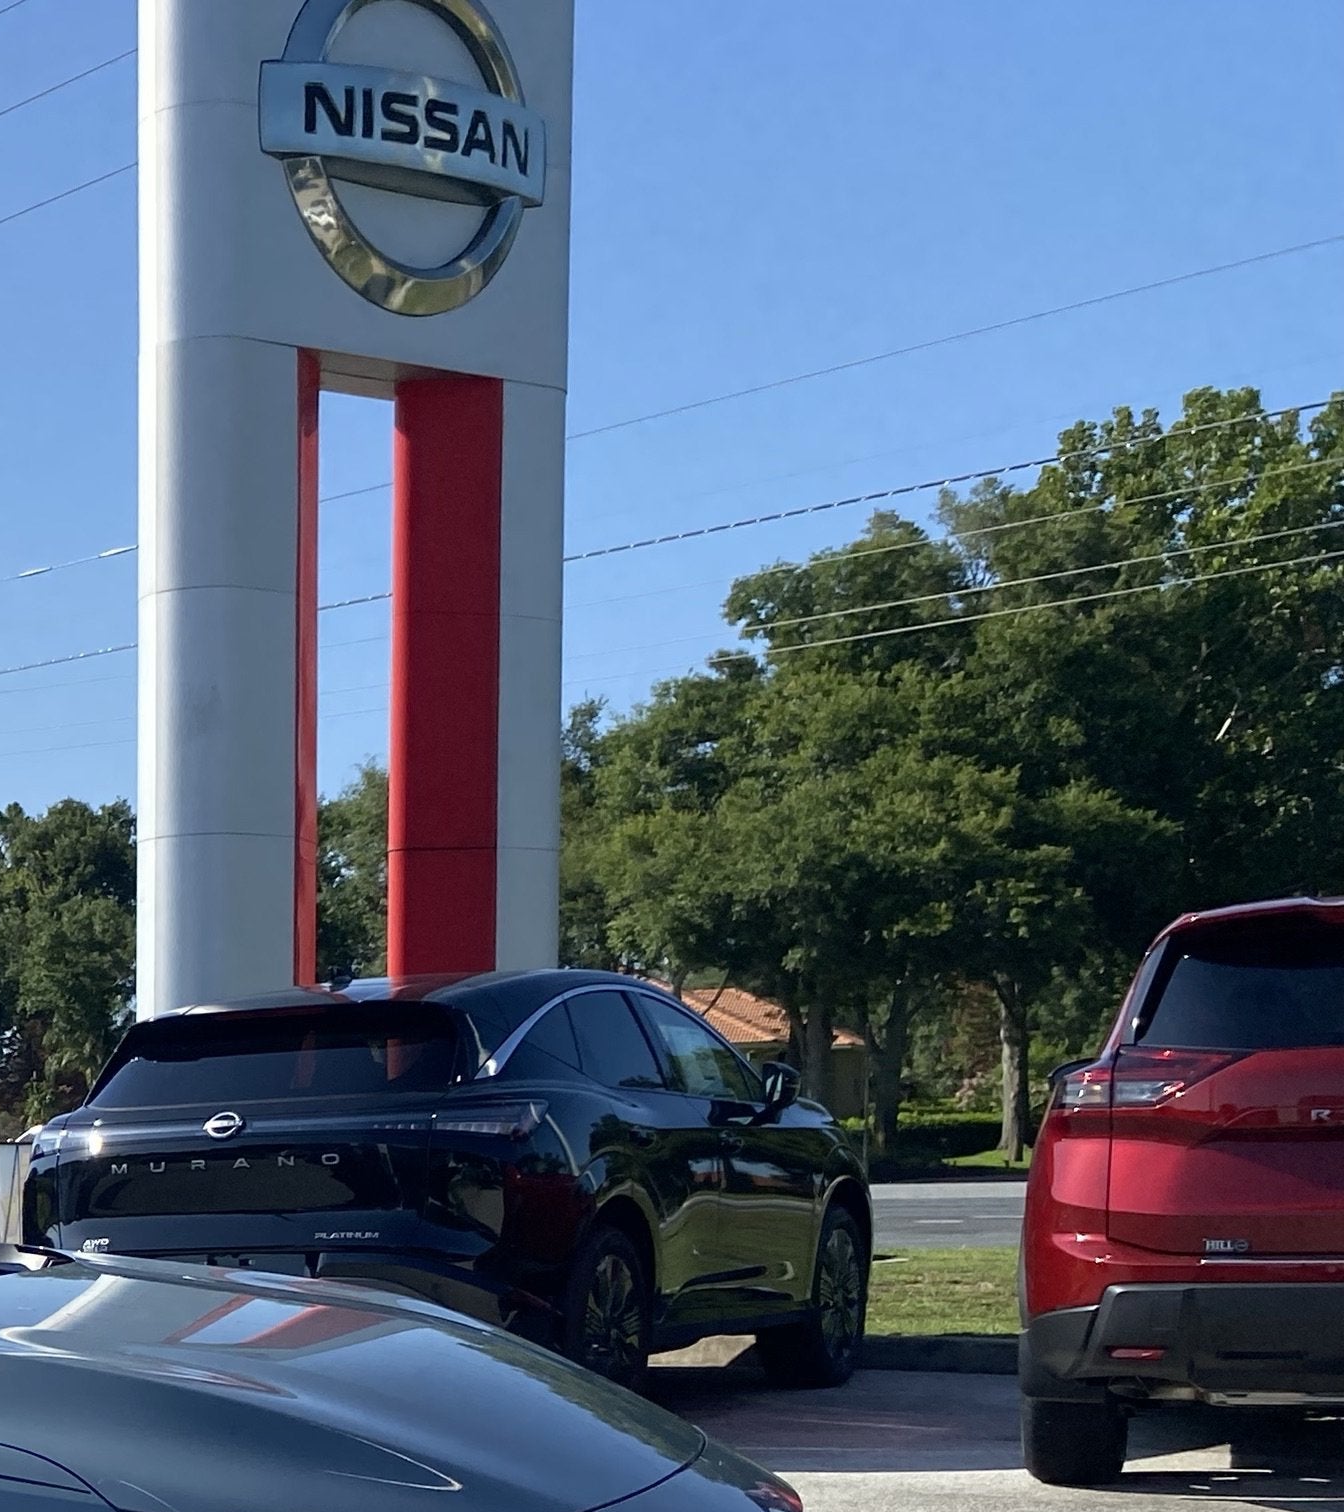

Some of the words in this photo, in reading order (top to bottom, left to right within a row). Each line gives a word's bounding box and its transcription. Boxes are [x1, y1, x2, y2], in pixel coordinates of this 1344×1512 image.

[303, 81, 529, 177] NISSAN
[111, 1153, 340, 1175] MURANO
[314, 1231, 379, 1239] PLATINUM
[83, 1238, 109, 1247] AWD
[1203, 1239, 1234, 1252] HILL
